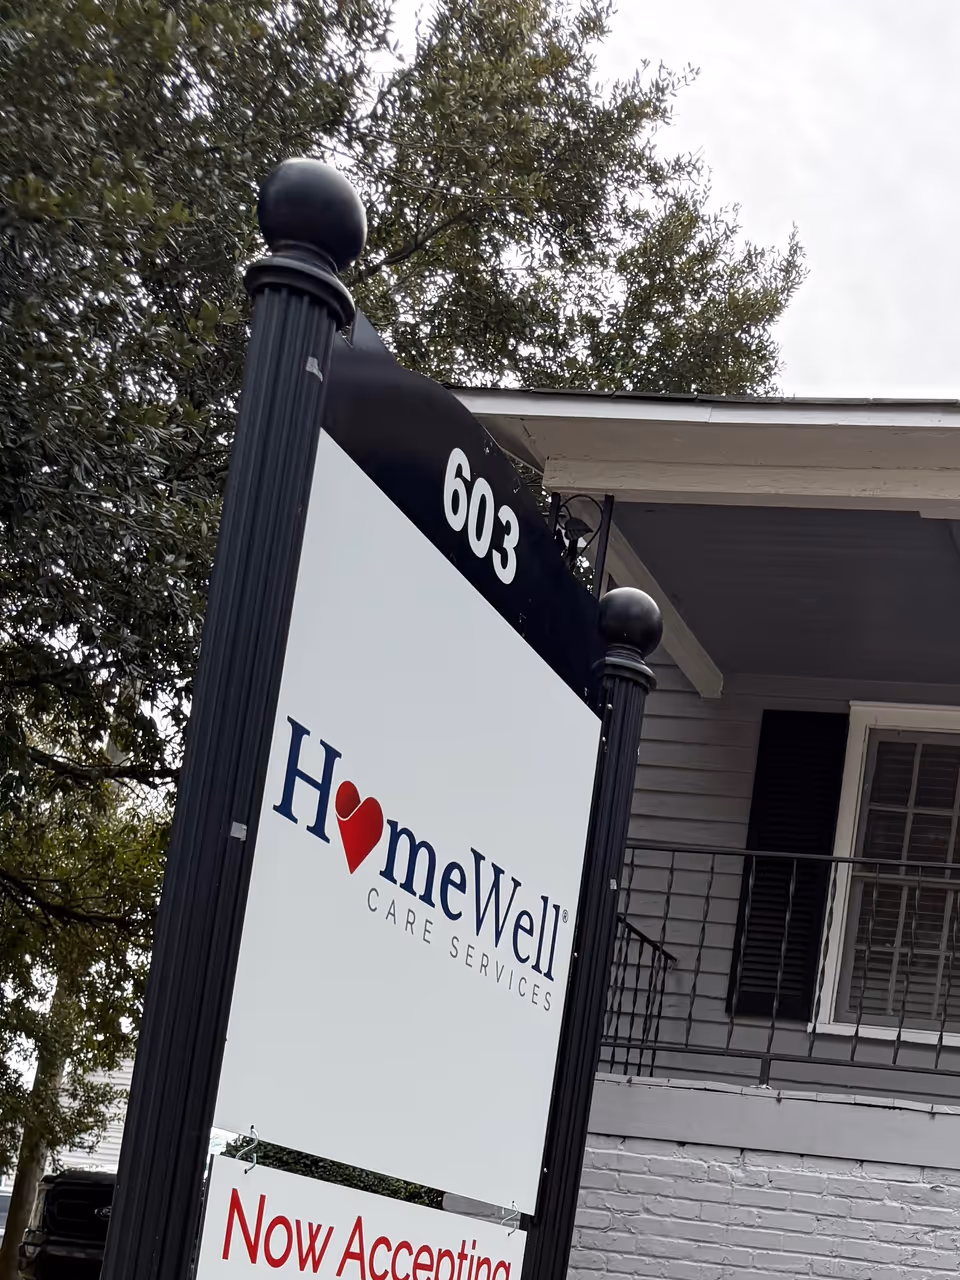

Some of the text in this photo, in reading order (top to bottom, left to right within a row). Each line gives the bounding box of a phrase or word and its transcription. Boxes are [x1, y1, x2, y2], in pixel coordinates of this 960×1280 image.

[443, 448, 520, 585] 603
[367, 887, 552, 1012] CARE SERVICES
[222, 1187, 334, 1274] Now
